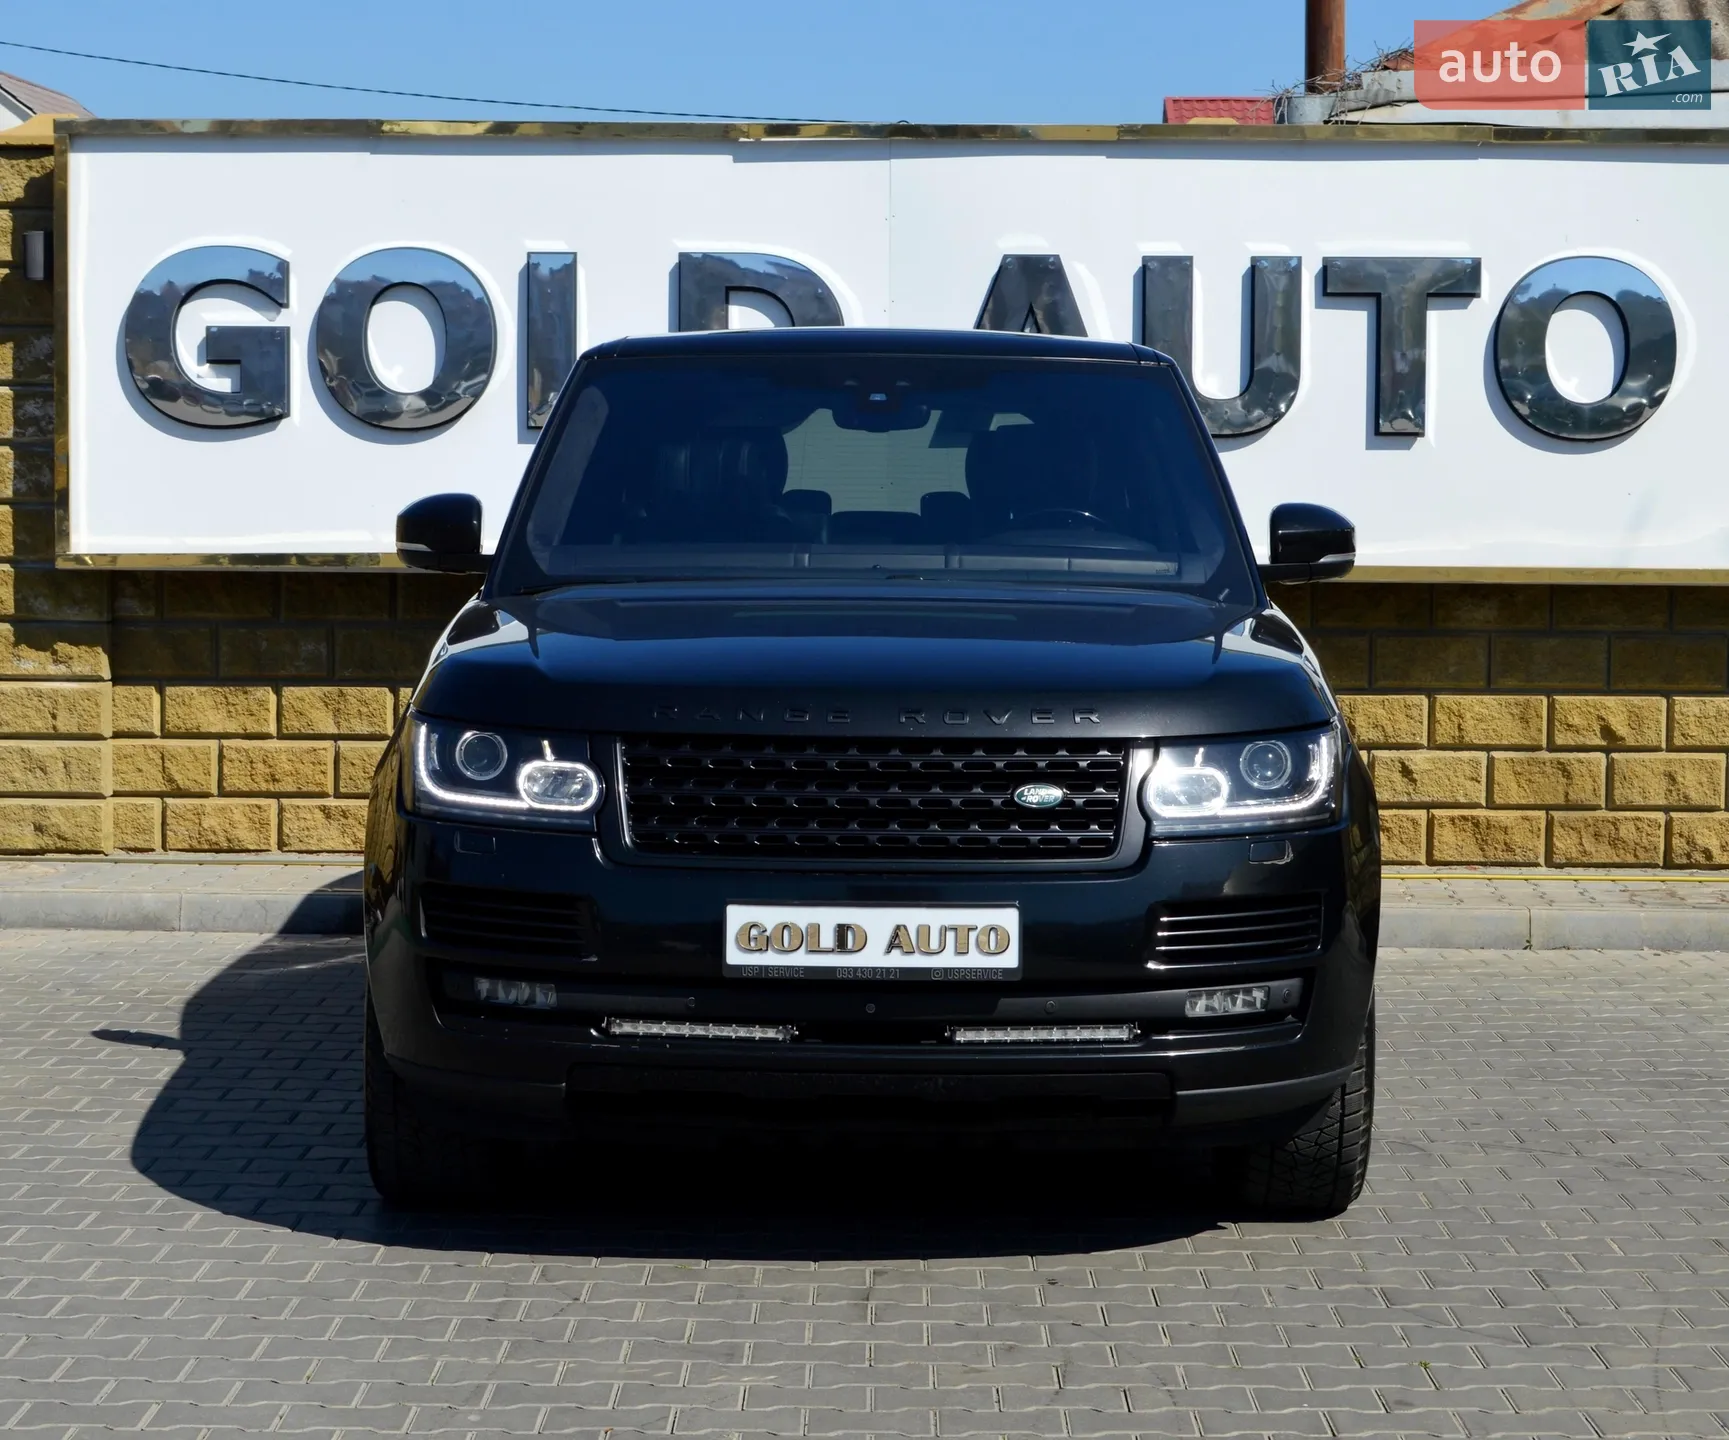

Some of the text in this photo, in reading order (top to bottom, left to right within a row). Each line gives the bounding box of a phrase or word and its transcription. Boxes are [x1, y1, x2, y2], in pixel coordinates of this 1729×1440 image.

[652, 705, 1101, 725] RANGE ROVER
[1026, 795, 1055, 803] ROVER
[736, 921, 1010, 955] GOLD AUTO
[742, 966, 1003, 980] USP SERVICE 093 430 21 21 USPSERVICE
